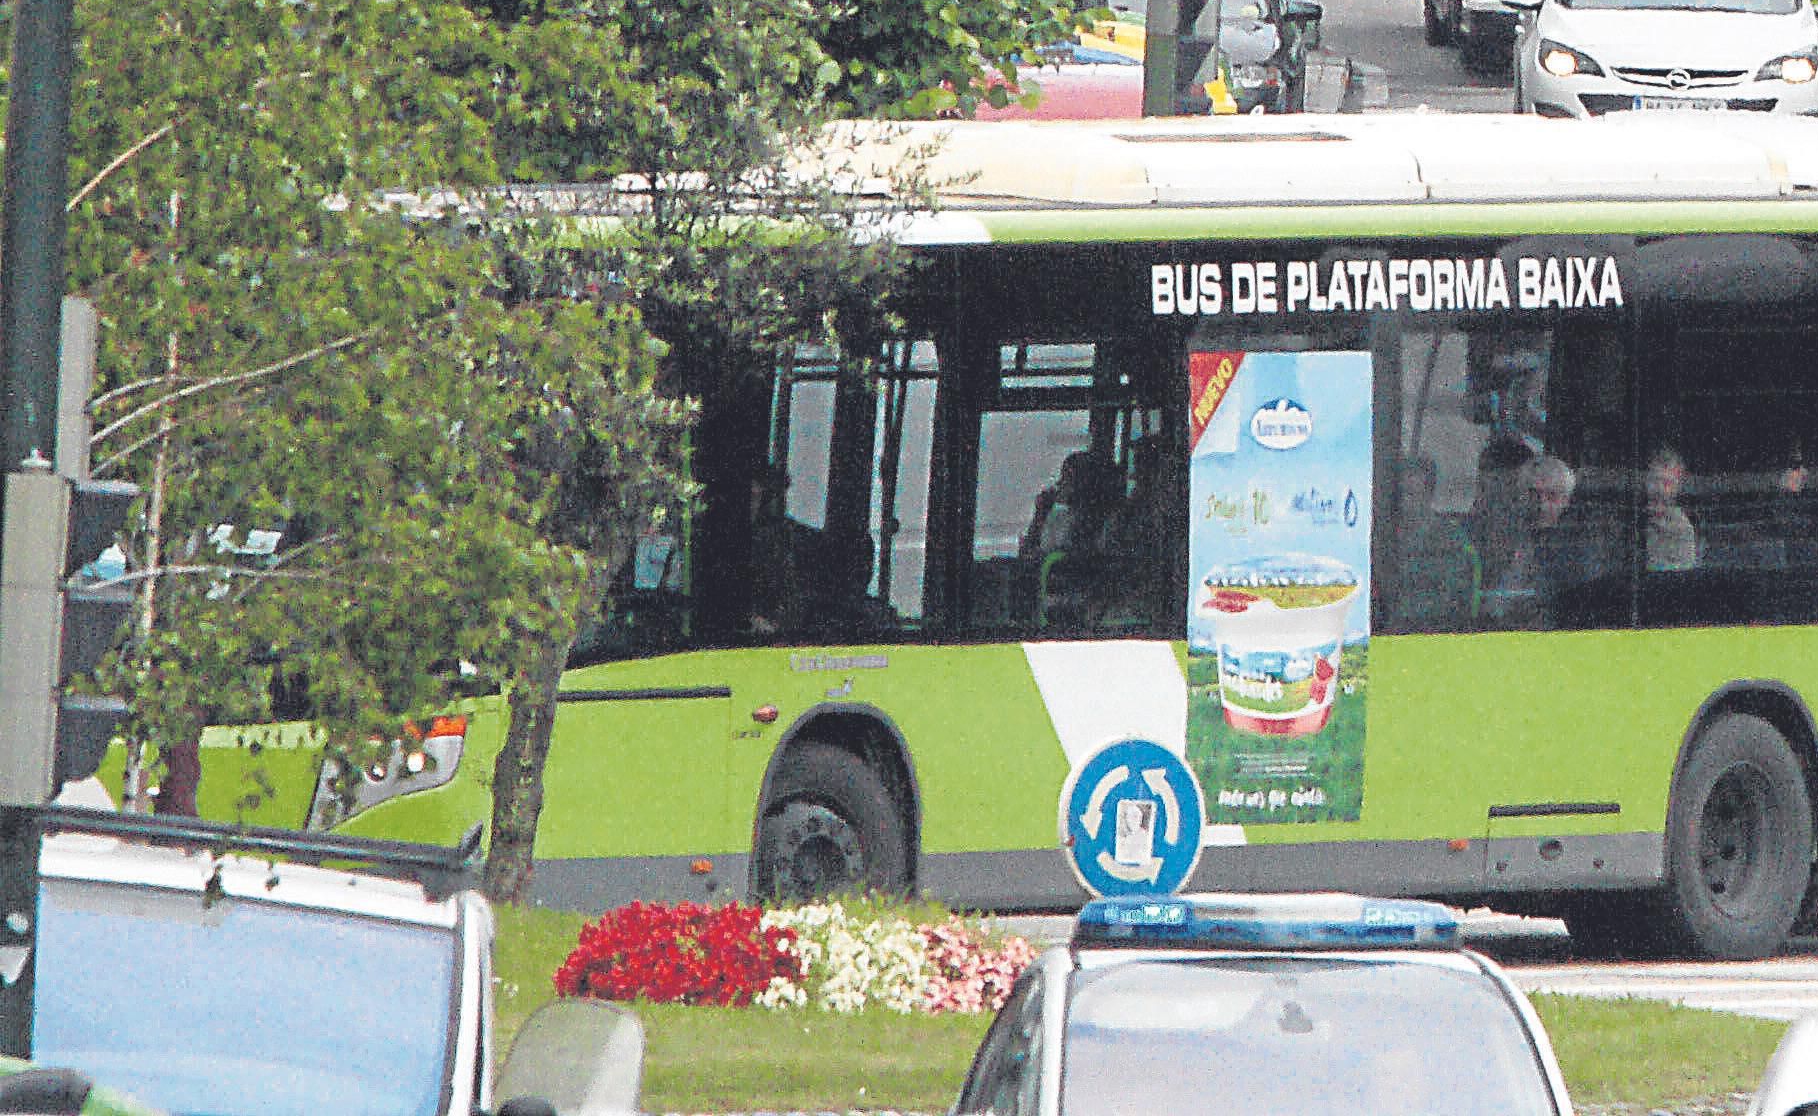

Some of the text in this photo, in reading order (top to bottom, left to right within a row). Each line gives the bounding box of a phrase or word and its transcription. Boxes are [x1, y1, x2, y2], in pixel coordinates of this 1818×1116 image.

[1150, 257, 1625, 315] BUS DE PLATAFORMA BAIXA
[1193, 357, 1233, 425] NUEVO
